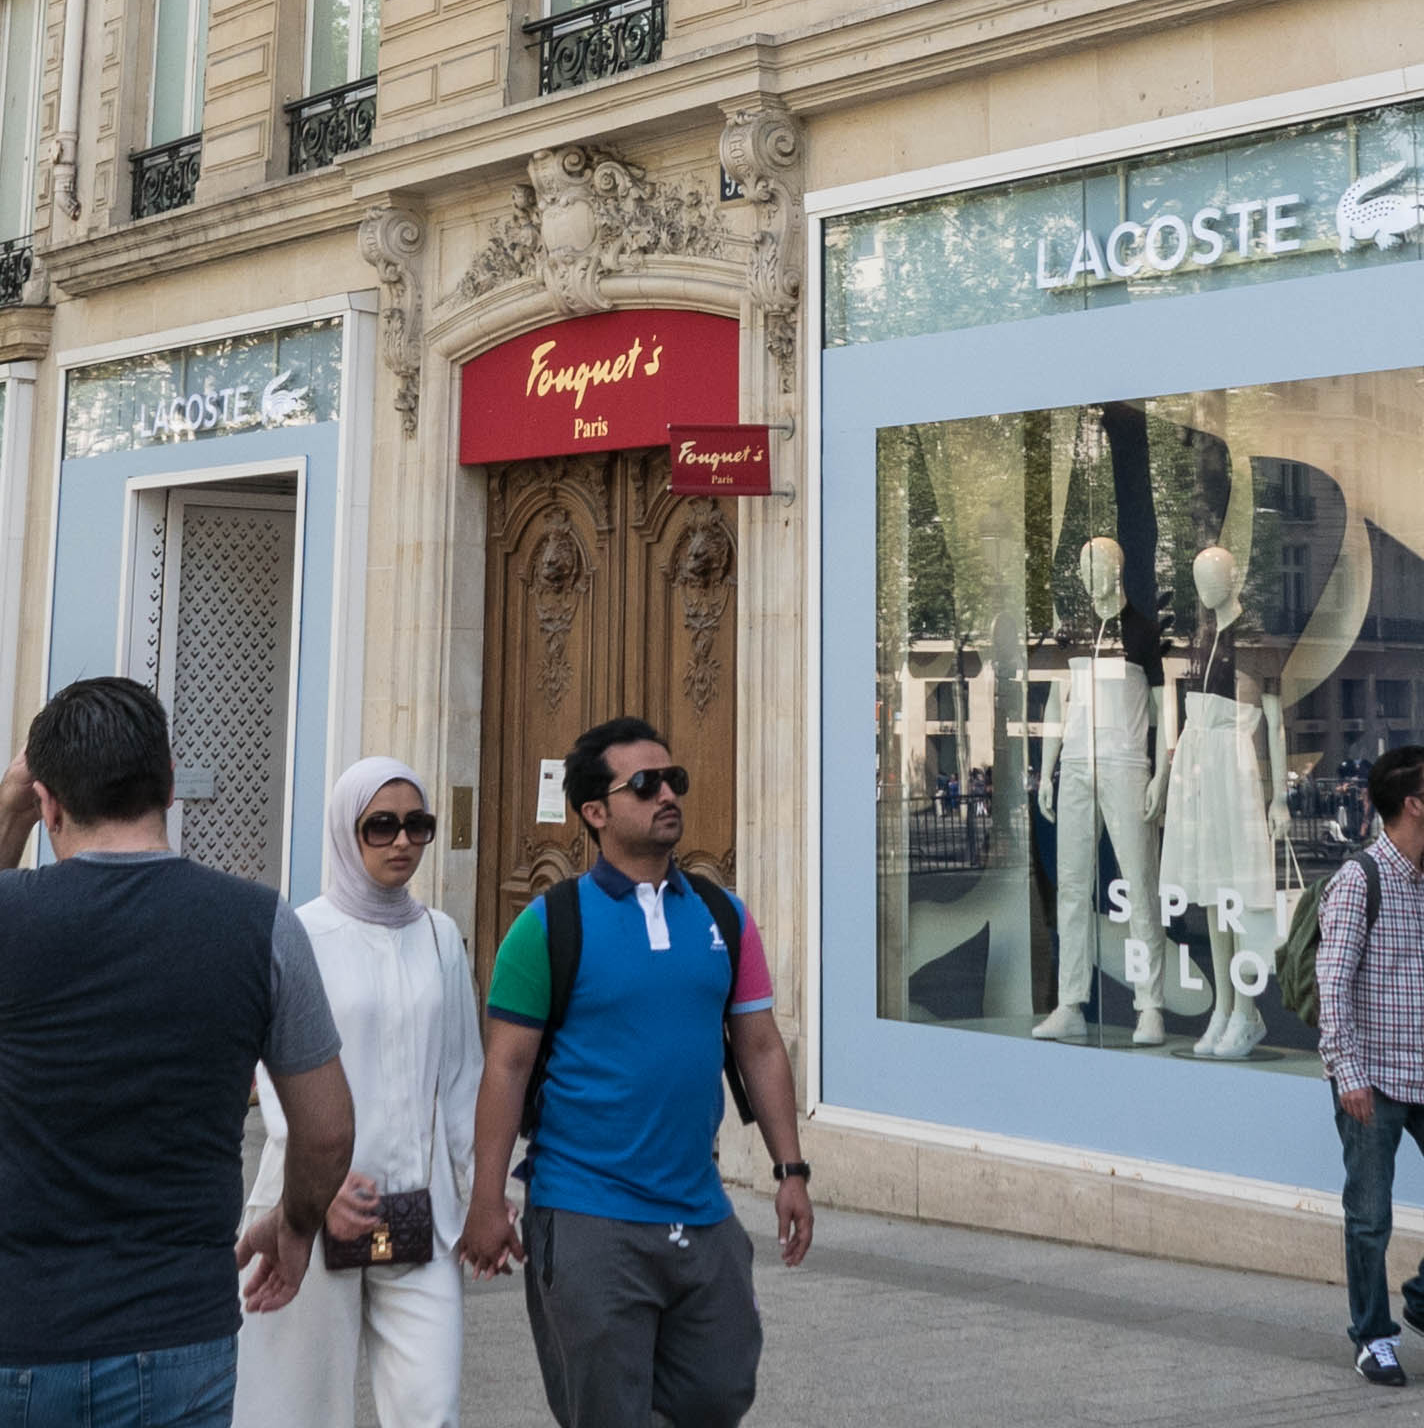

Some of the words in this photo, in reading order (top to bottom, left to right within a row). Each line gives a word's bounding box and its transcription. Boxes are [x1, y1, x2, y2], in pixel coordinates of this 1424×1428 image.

[1036, 193, 1303, 290] LACOSTE
[526, 334, 663, 410] Fouquet's
[140, 385, 250, 438] LACOSTE
[574, 416, 609, 440] Paris
[678, 440, 764, 472] Fouquet's
[711, 474, 734, 486] Paris
[1107, 878, 1288, 939] SPRI
[1125, 938, 1270, 997] BLO
